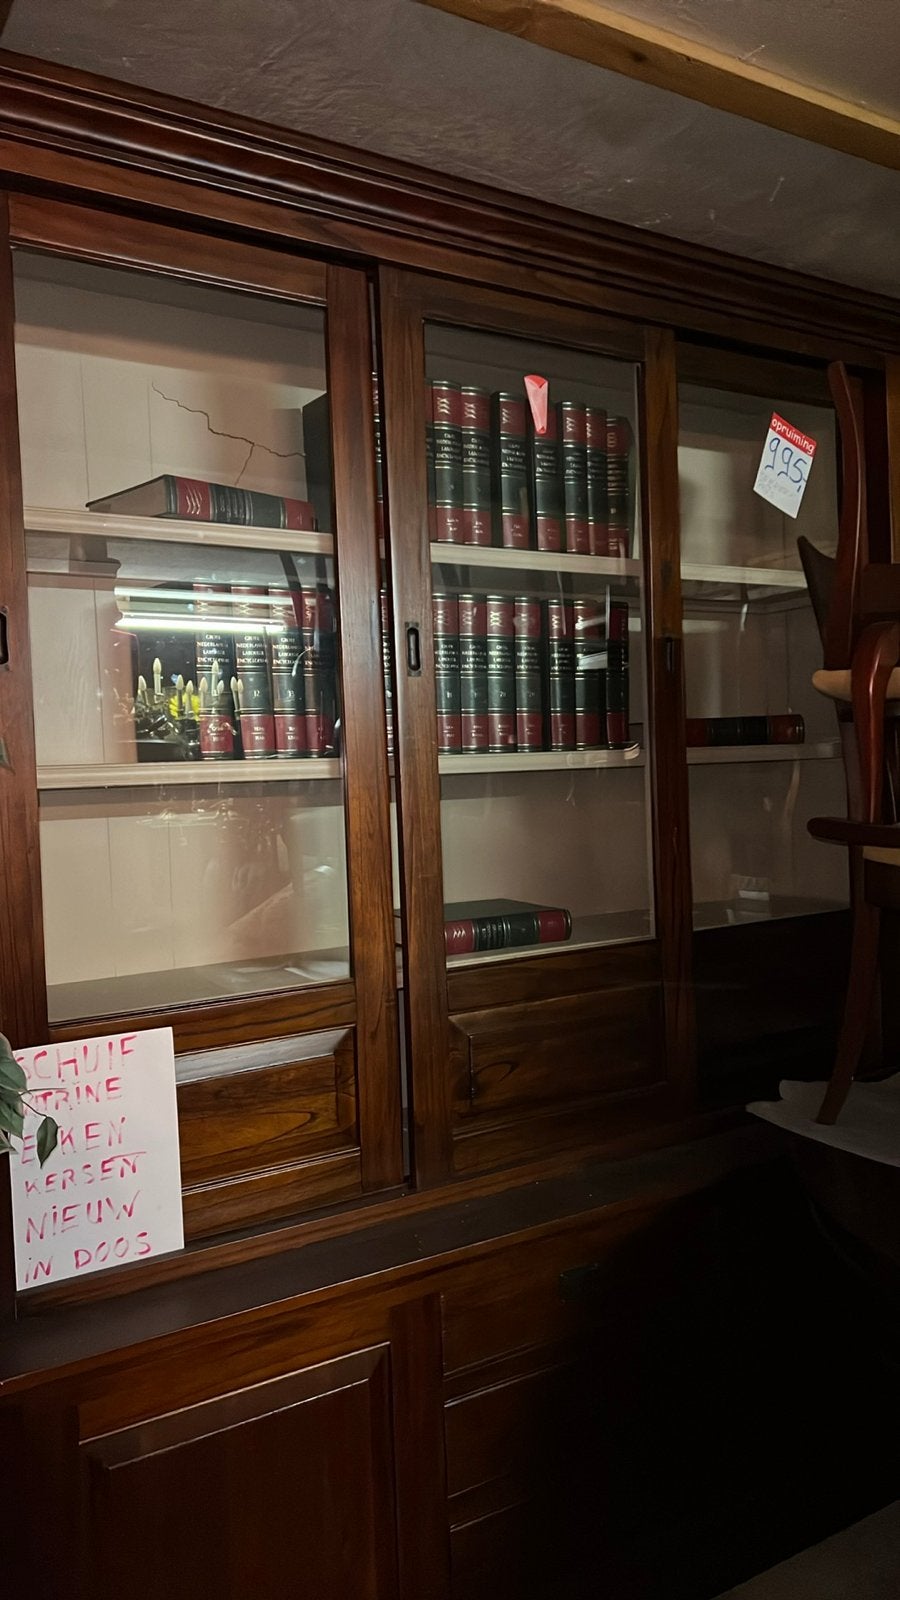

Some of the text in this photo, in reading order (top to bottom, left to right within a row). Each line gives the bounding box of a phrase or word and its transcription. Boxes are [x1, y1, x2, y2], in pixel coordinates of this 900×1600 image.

[771, 418, 816, 455] opruiming
[16, 1035, 137, 1080] SCHUIF
[21, 1117, 126, 1165] EKEN
[25, 1153, 142, 1197] KERSEN
[74, 1231, 151, 1269] DOOS
